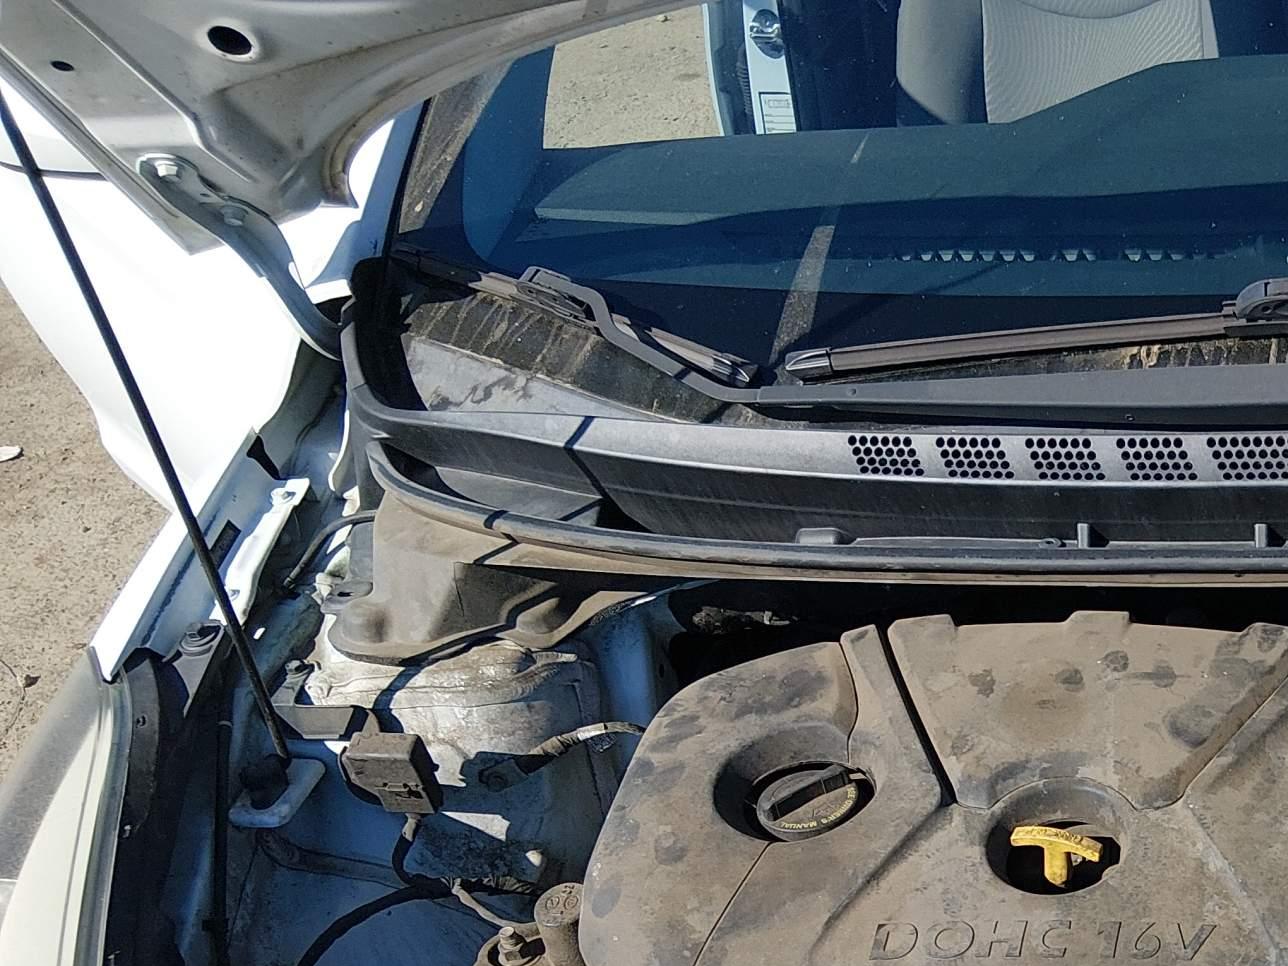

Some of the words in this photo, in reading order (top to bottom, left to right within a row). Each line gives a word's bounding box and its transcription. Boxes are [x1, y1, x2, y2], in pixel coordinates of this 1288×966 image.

[821, 799, 854, 824] OWNER'S
[780, 820, 818, 830] MANUAL
[869, 919, 1072, 961] DOHC
[1097, 921, 1217, 961] 16V
